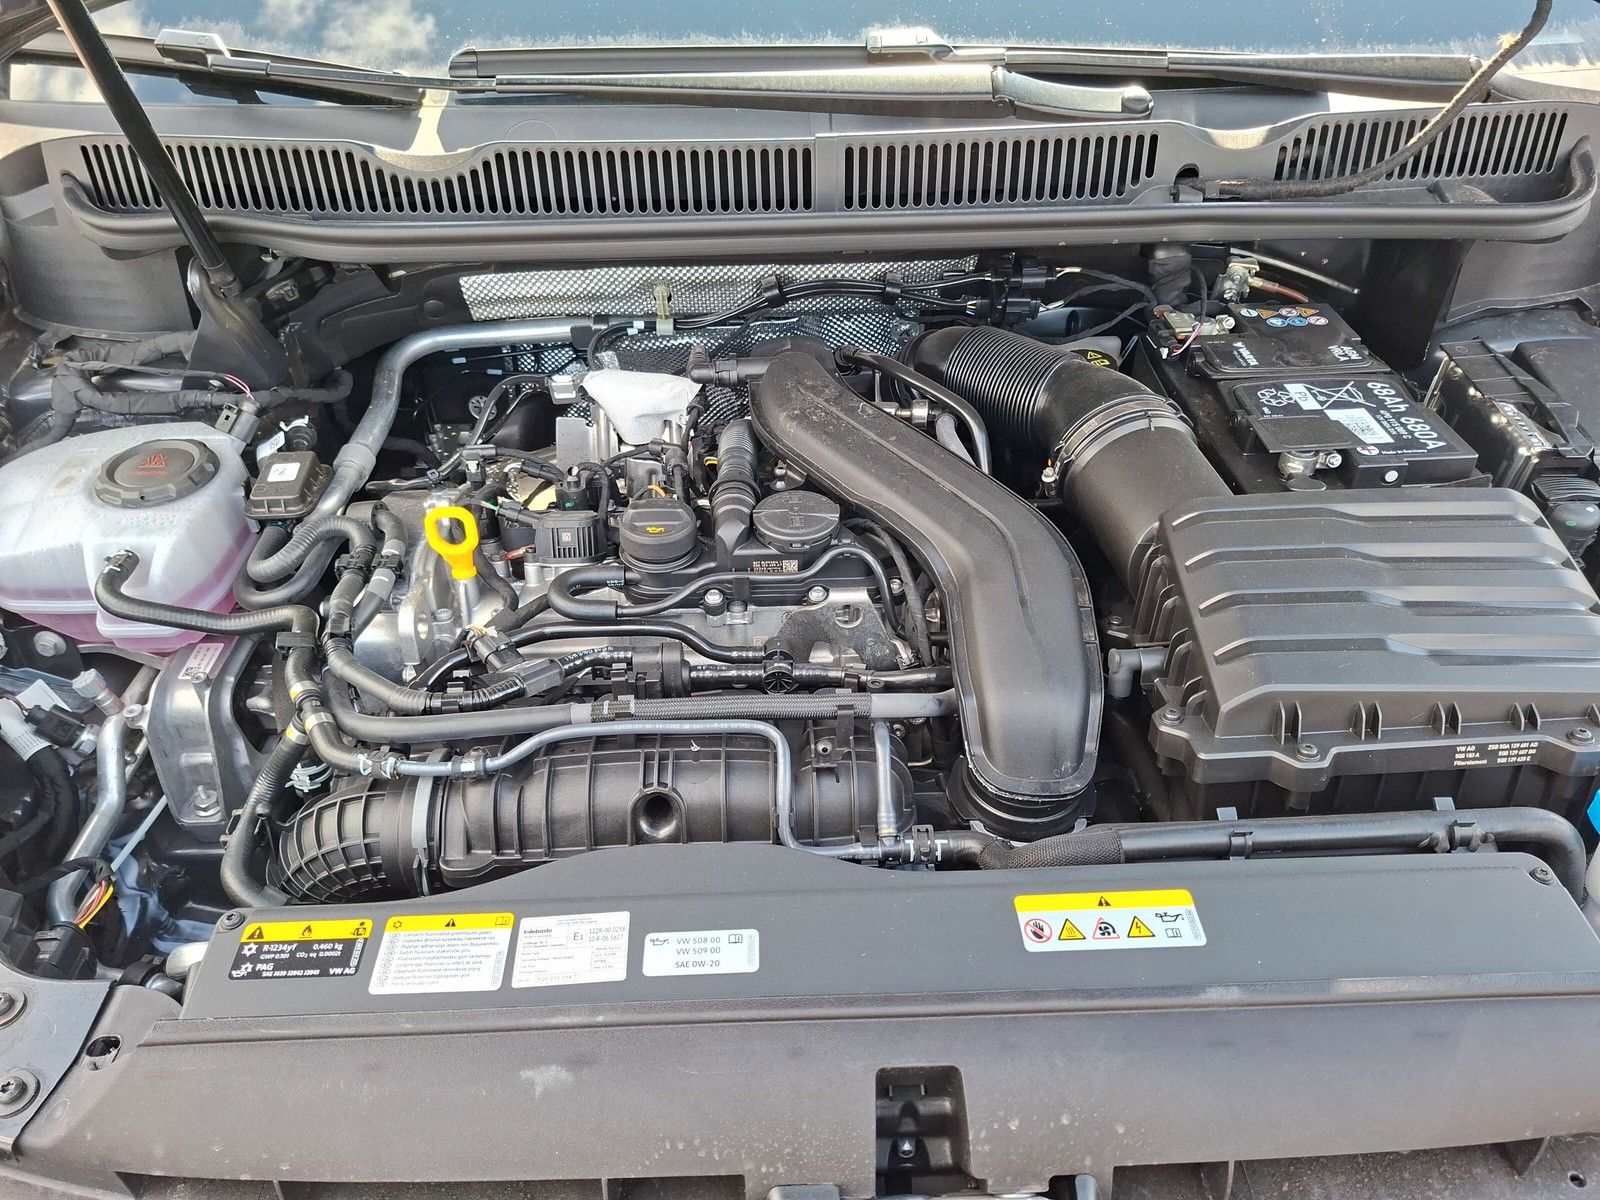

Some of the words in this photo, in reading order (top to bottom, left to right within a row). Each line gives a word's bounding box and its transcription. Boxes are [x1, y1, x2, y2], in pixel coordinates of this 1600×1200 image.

[1294, 391, 1308, 401] Pb
[1367, 382, 1409, 412] 68Ah
[1400, 417, 1447, 449] 680A
[262, 943, 298, 953] R-1234yf
[334, 943, 344, 951] kg
[255, 962, 274, 971] PAG
[675, 961, 690, 969] SAE
[692, 960, 720, 968] 0W-20
